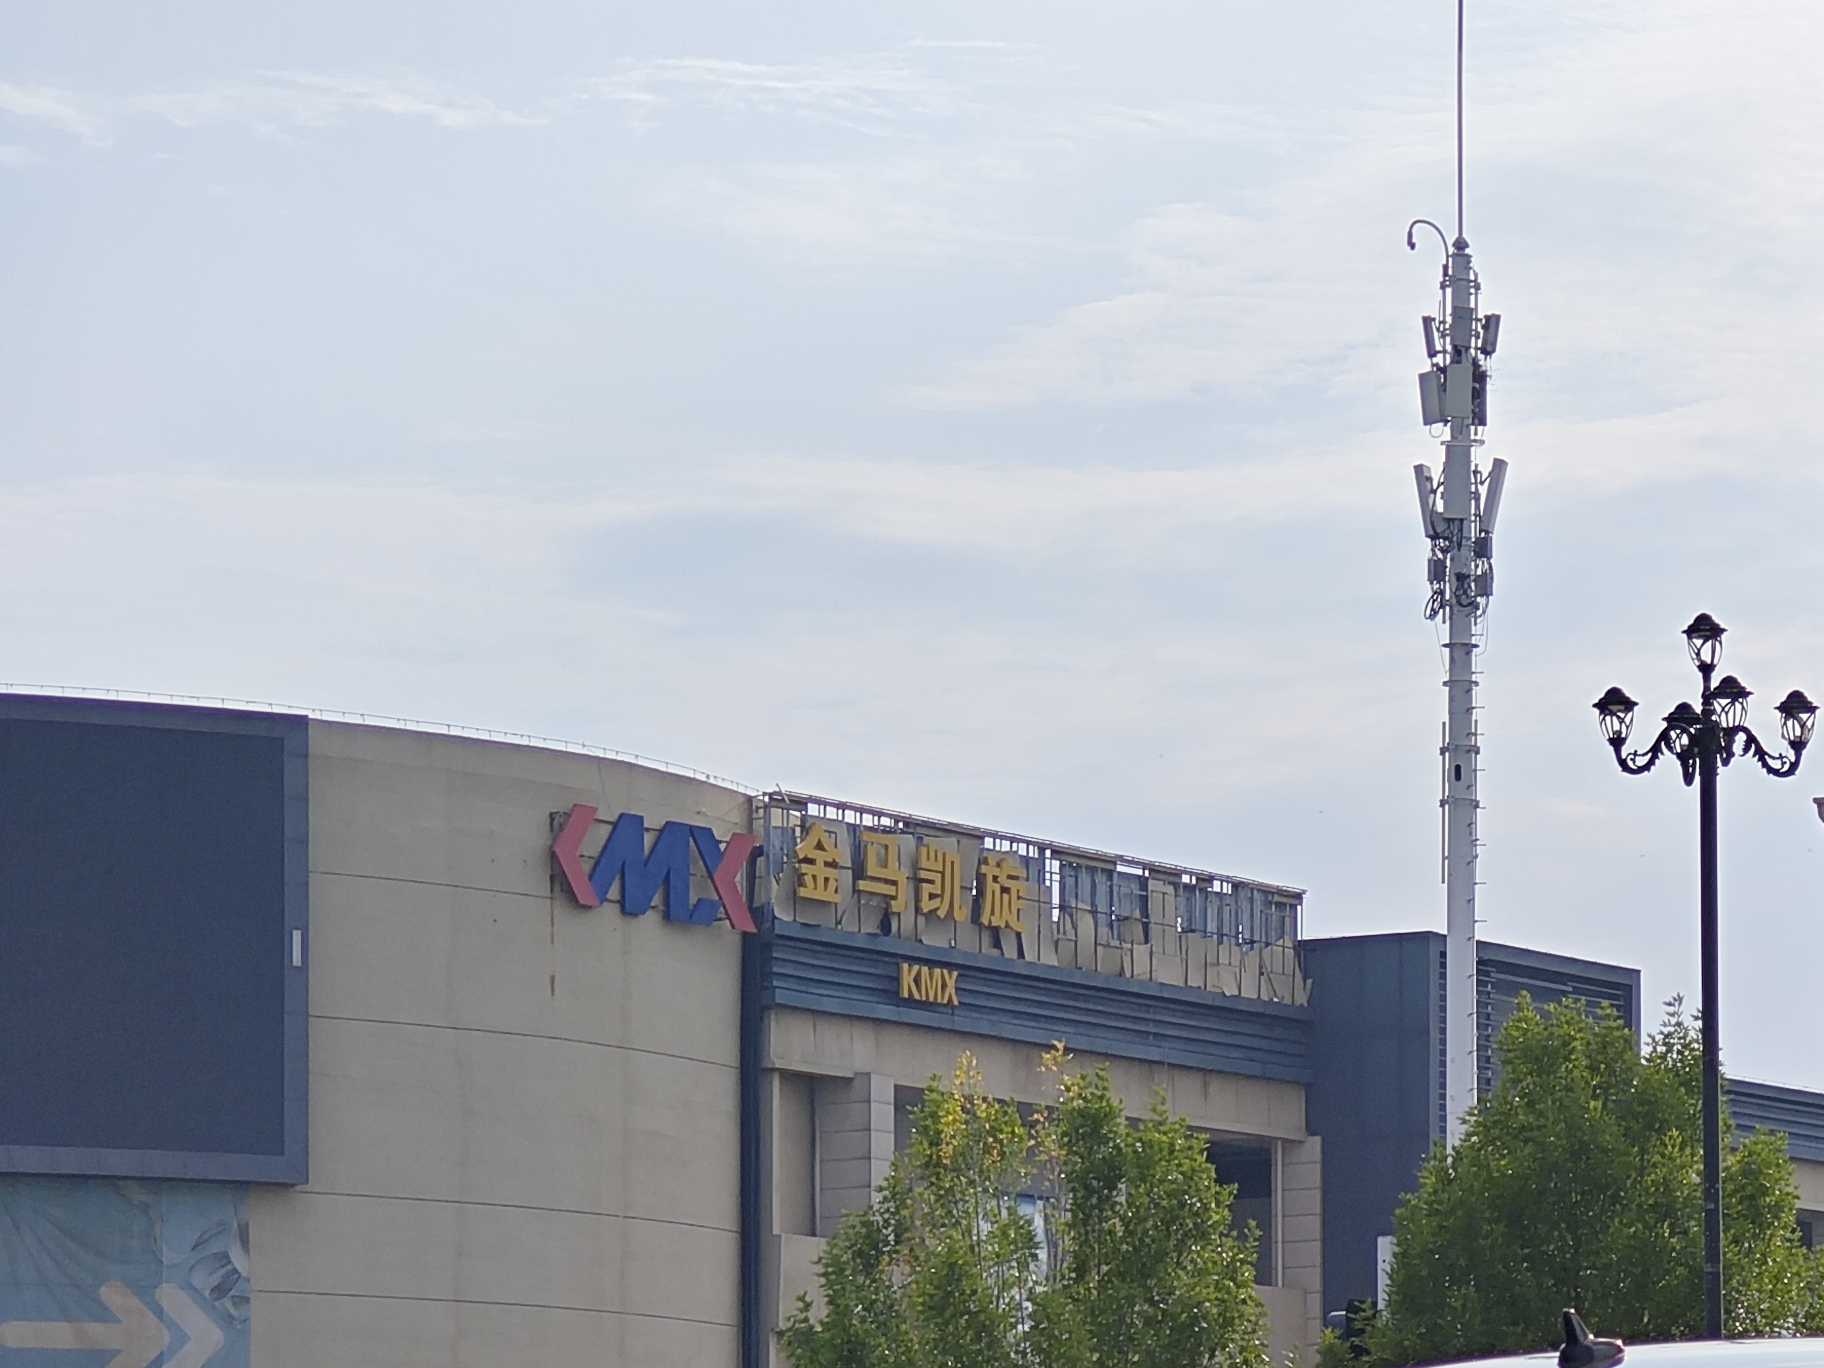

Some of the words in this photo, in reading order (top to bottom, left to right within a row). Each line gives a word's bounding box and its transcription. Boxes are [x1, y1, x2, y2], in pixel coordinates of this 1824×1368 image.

[795, 821, 1028, 933] 金马凯旋
[898, 962, 960, 1007] KMX
